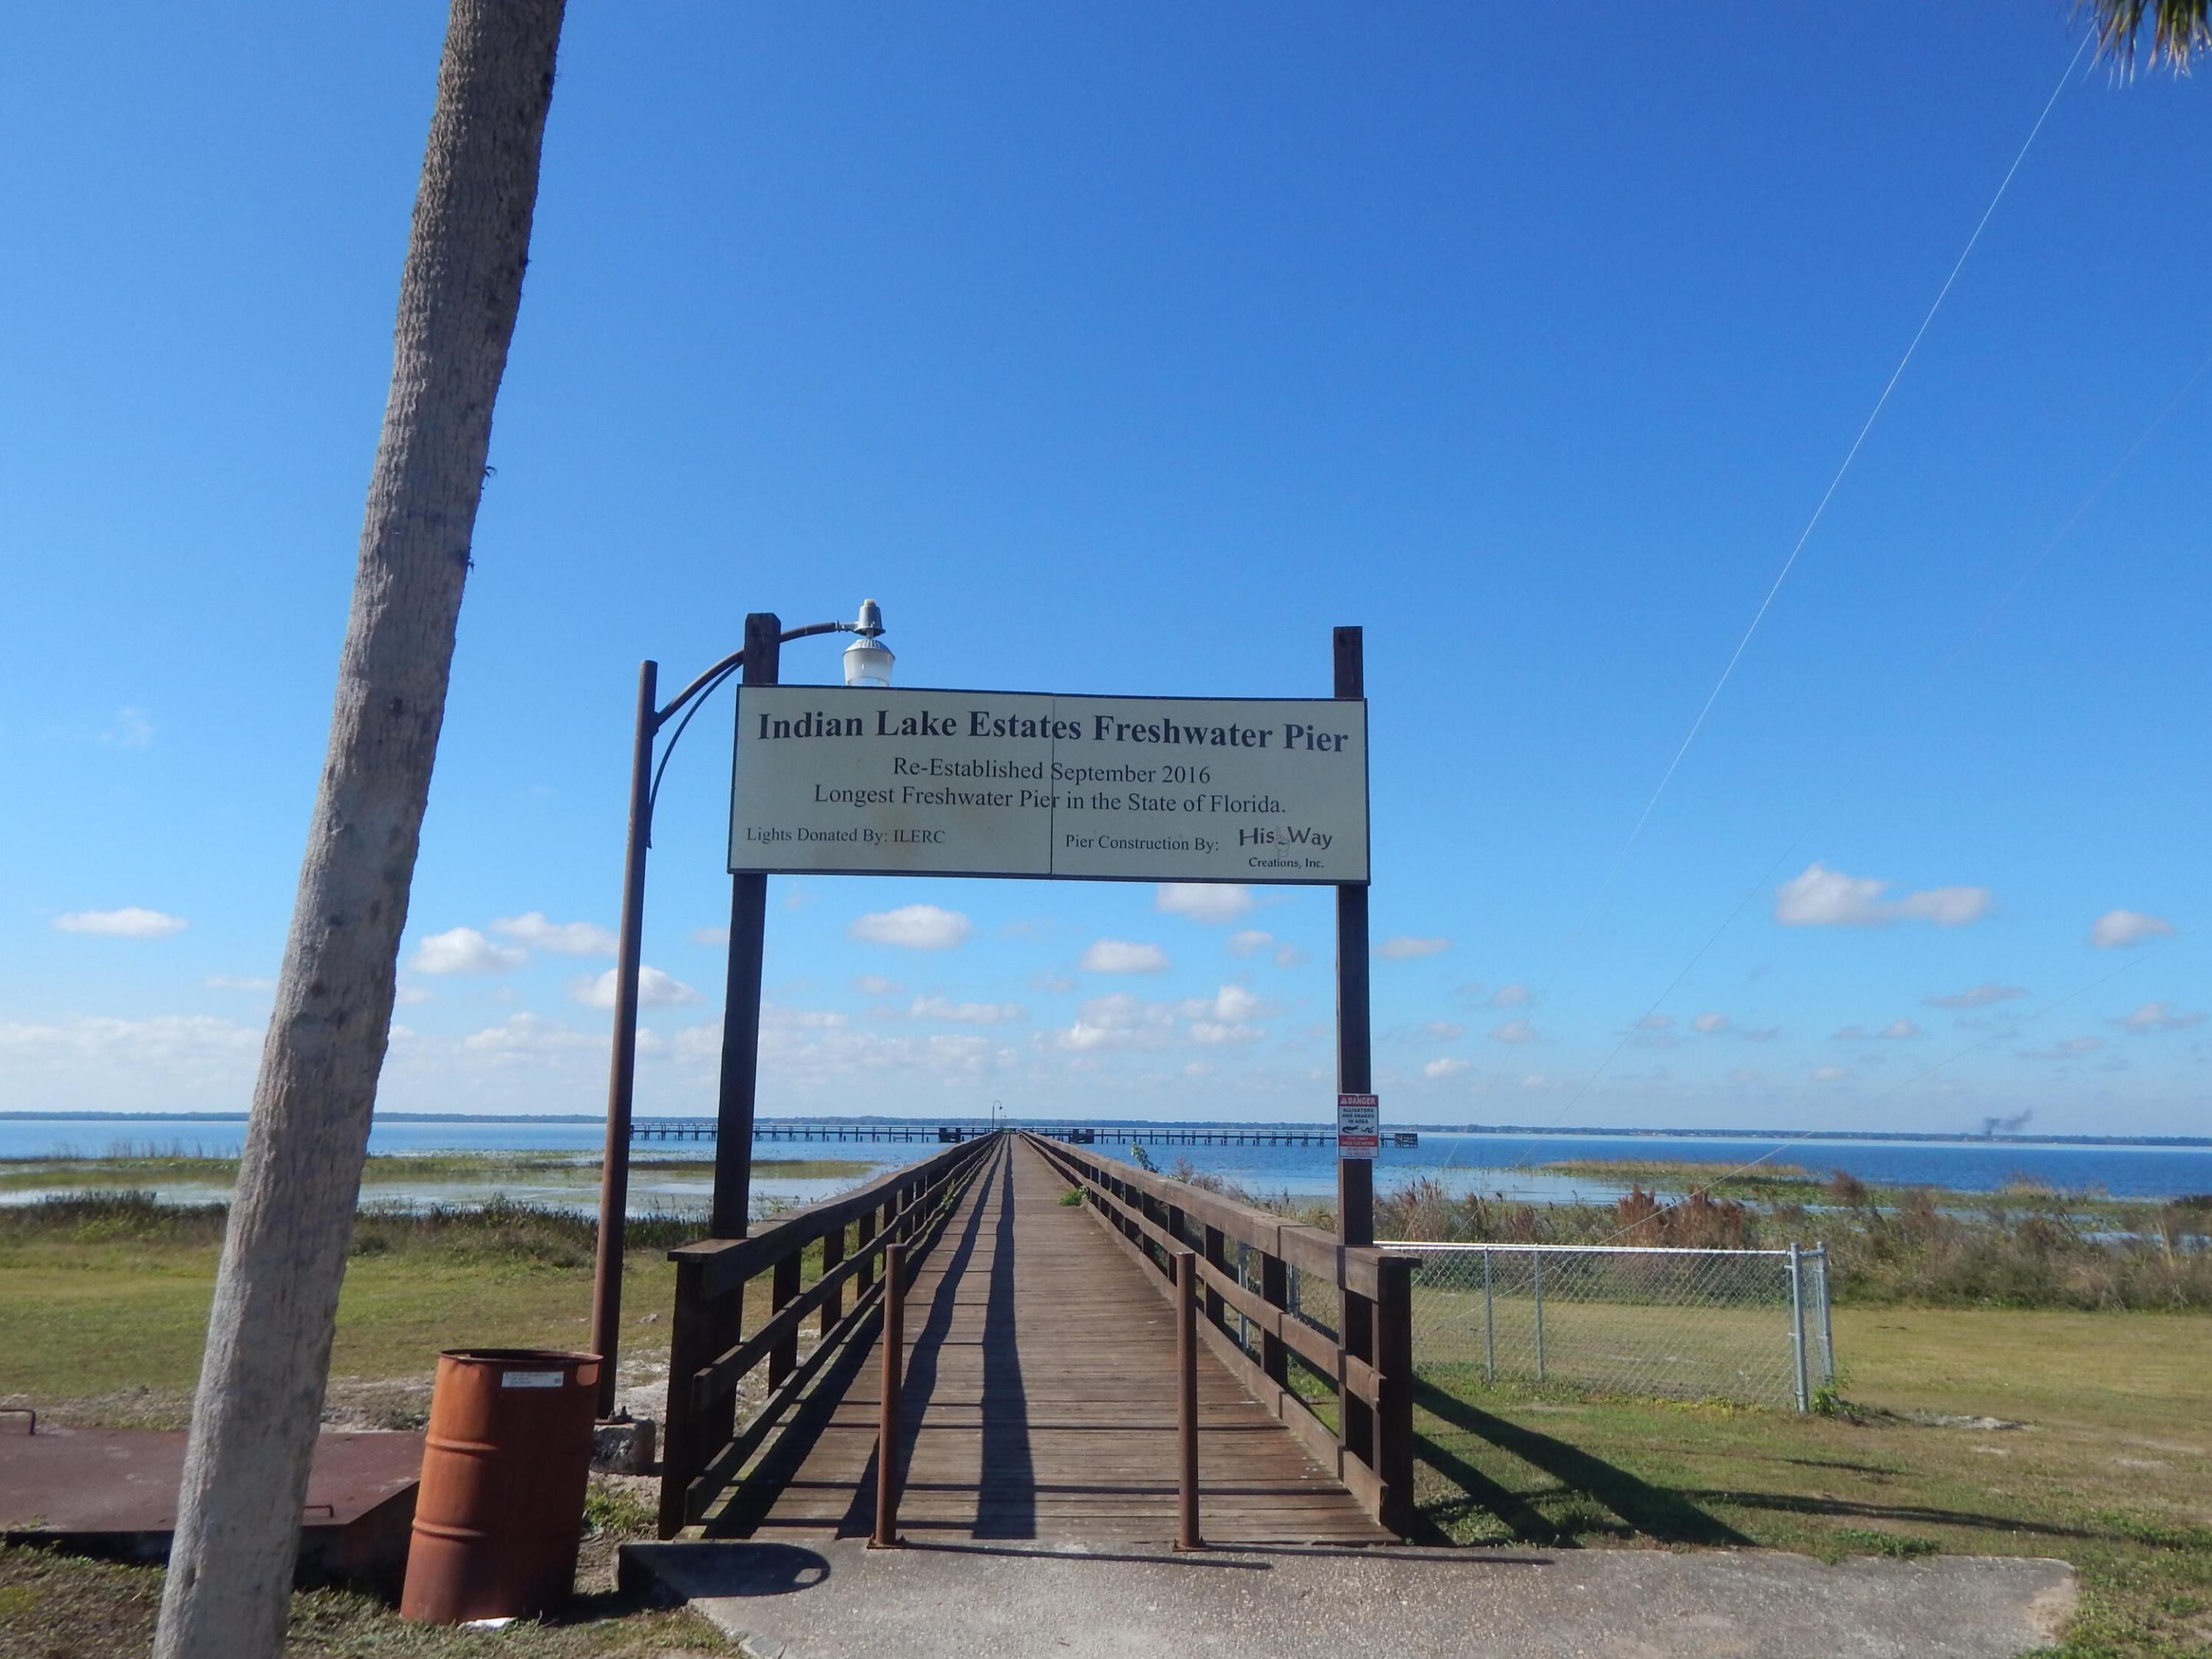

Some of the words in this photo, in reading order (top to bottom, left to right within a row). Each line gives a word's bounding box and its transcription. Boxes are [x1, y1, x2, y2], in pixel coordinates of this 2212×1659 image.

[757, 710, 864, 740] Indian
[874, 710, 957, 737] Lake
[967, 710, 1081, 740] Estates
[1091, 714, 1273, 749] Freshwater
[1283, 724, 1349, 753] Pier
[893, 757, 1044, 780] Re-Established
[1050, 762, 1157, 786] September
[1161, 765, 1211, 784] 2016
[814, 783, 896, 808] Longest
[902, 786, 1014, 807] Freshwater
[1019, 789, 1061, 809] Pier
[1067, 790, 1084, 810] in
[1091, 792, 1121, 811] the
[1128, 793, 1177, 812] State
[1183, 793, 1207, 813] of
[1210, 794, 1286, 813] Florida.
[747, 826, 793, 844] Lights
[797, 827, 858, 843] Donated
[863, 828, 888, 846] By:
[894, 829, 945, 844] ILERC
[1065, 834, 1094, 849] Pier
[1098, 835, 1190, 851] Construction
[1194, 837, 1219, 855] By:
[1239, 826, 1275, 847] His
[1286, 826, 1333, 851] Way
[1248, 856, 1302, 869] Creations,
[1305, 857, 1324, 869] Inc.
[1348, 1097, 1376, 1105] DANGER
